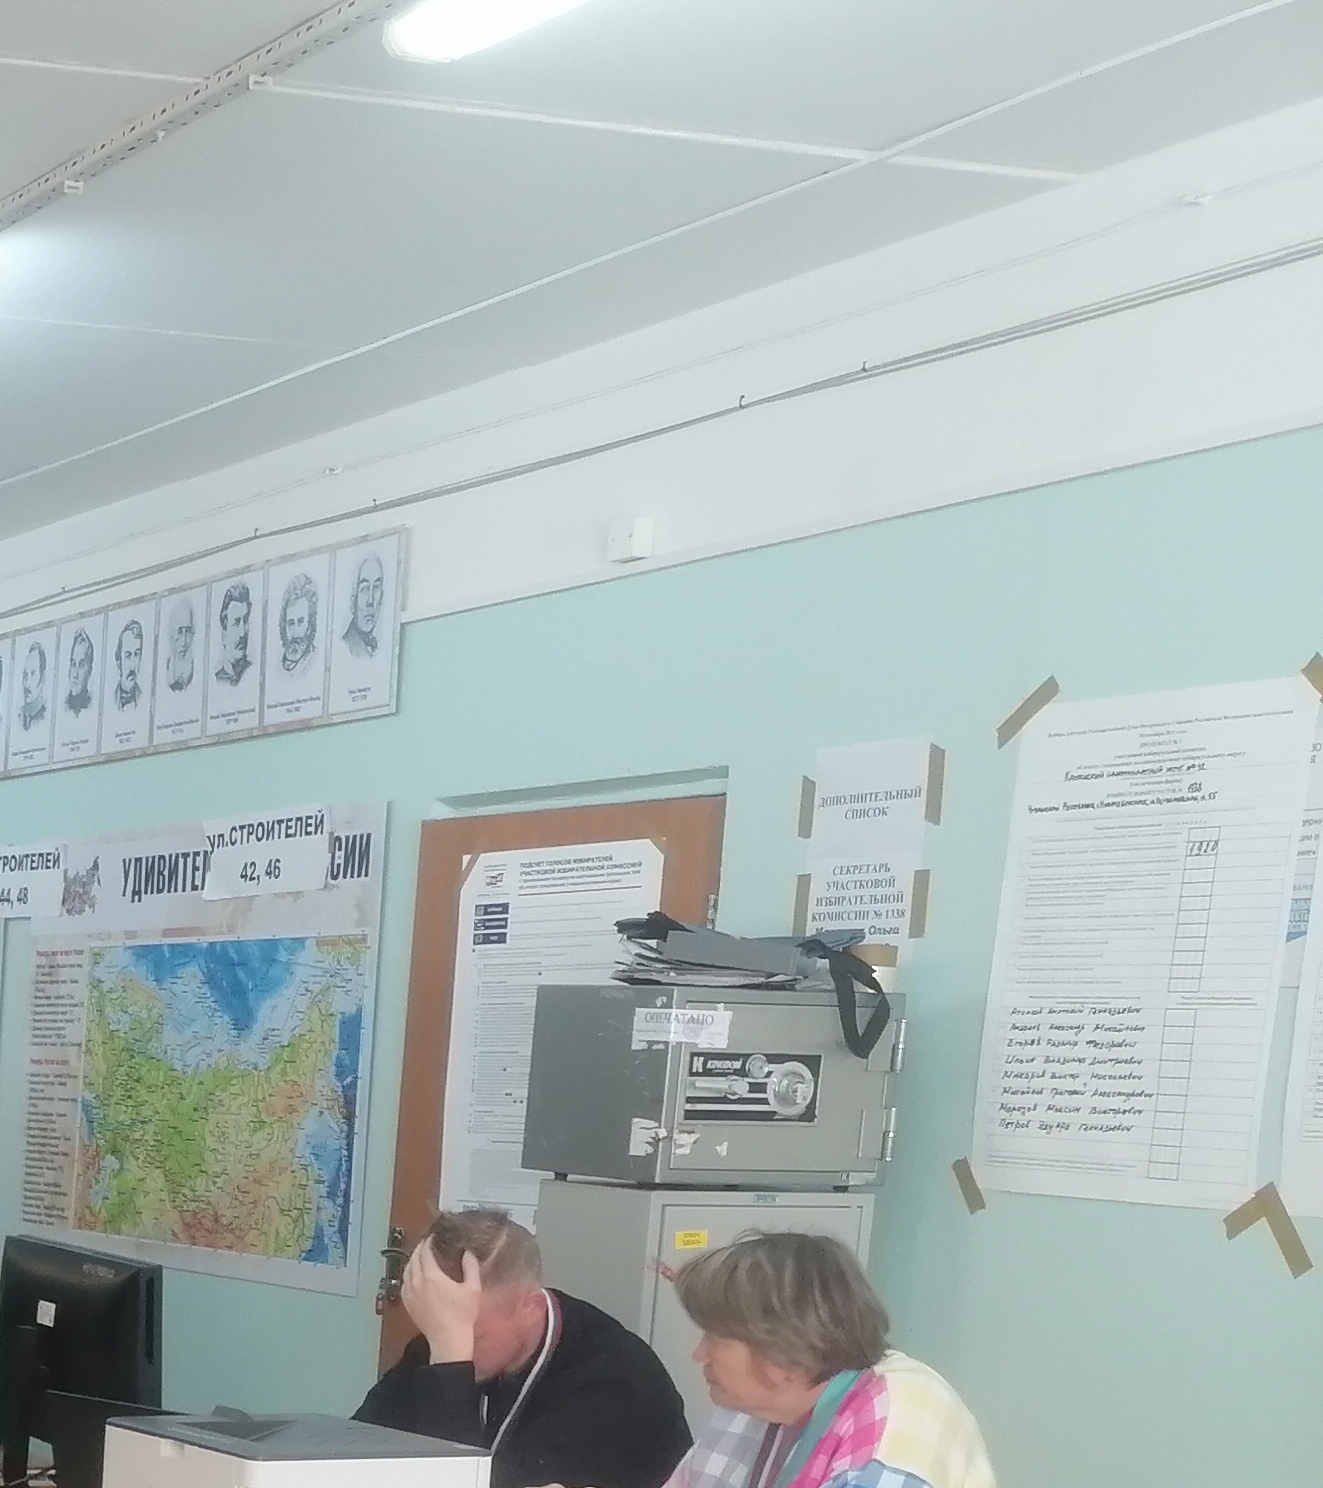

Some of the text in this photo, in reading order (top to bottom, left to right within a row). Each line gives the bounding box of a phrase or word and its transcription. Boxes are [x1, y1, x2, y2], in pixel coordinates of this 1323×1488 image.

[818, 785, 922, 809] ДОПОЛНИТЕЛЬНЫЙ
[844, 806, 889, 821] СПИСОК
[207, 808, 325, 855] ул.СТРОИТЕЛЕЙ
[325, 832, 372, 881] СИИ
[240, 858, 282, 886] 42, 46
[832, 863, 891, 876] СЕКРЕТАРЬ
[826, 876, 896, 891] УЧАСТКОВОЙ
[0, 886, 29, 910] 44, 48
[816, 891, 905, 907] ИЗБИРАТЕЛЬНОЙ
[811, 910, 869, 923] КОМИССИИ
[885, 908, 906, 920] 1338
[868, 925, 900, 935] Ольга
[645, 1012, 715, 1026] ОПЕЧАТАНО
